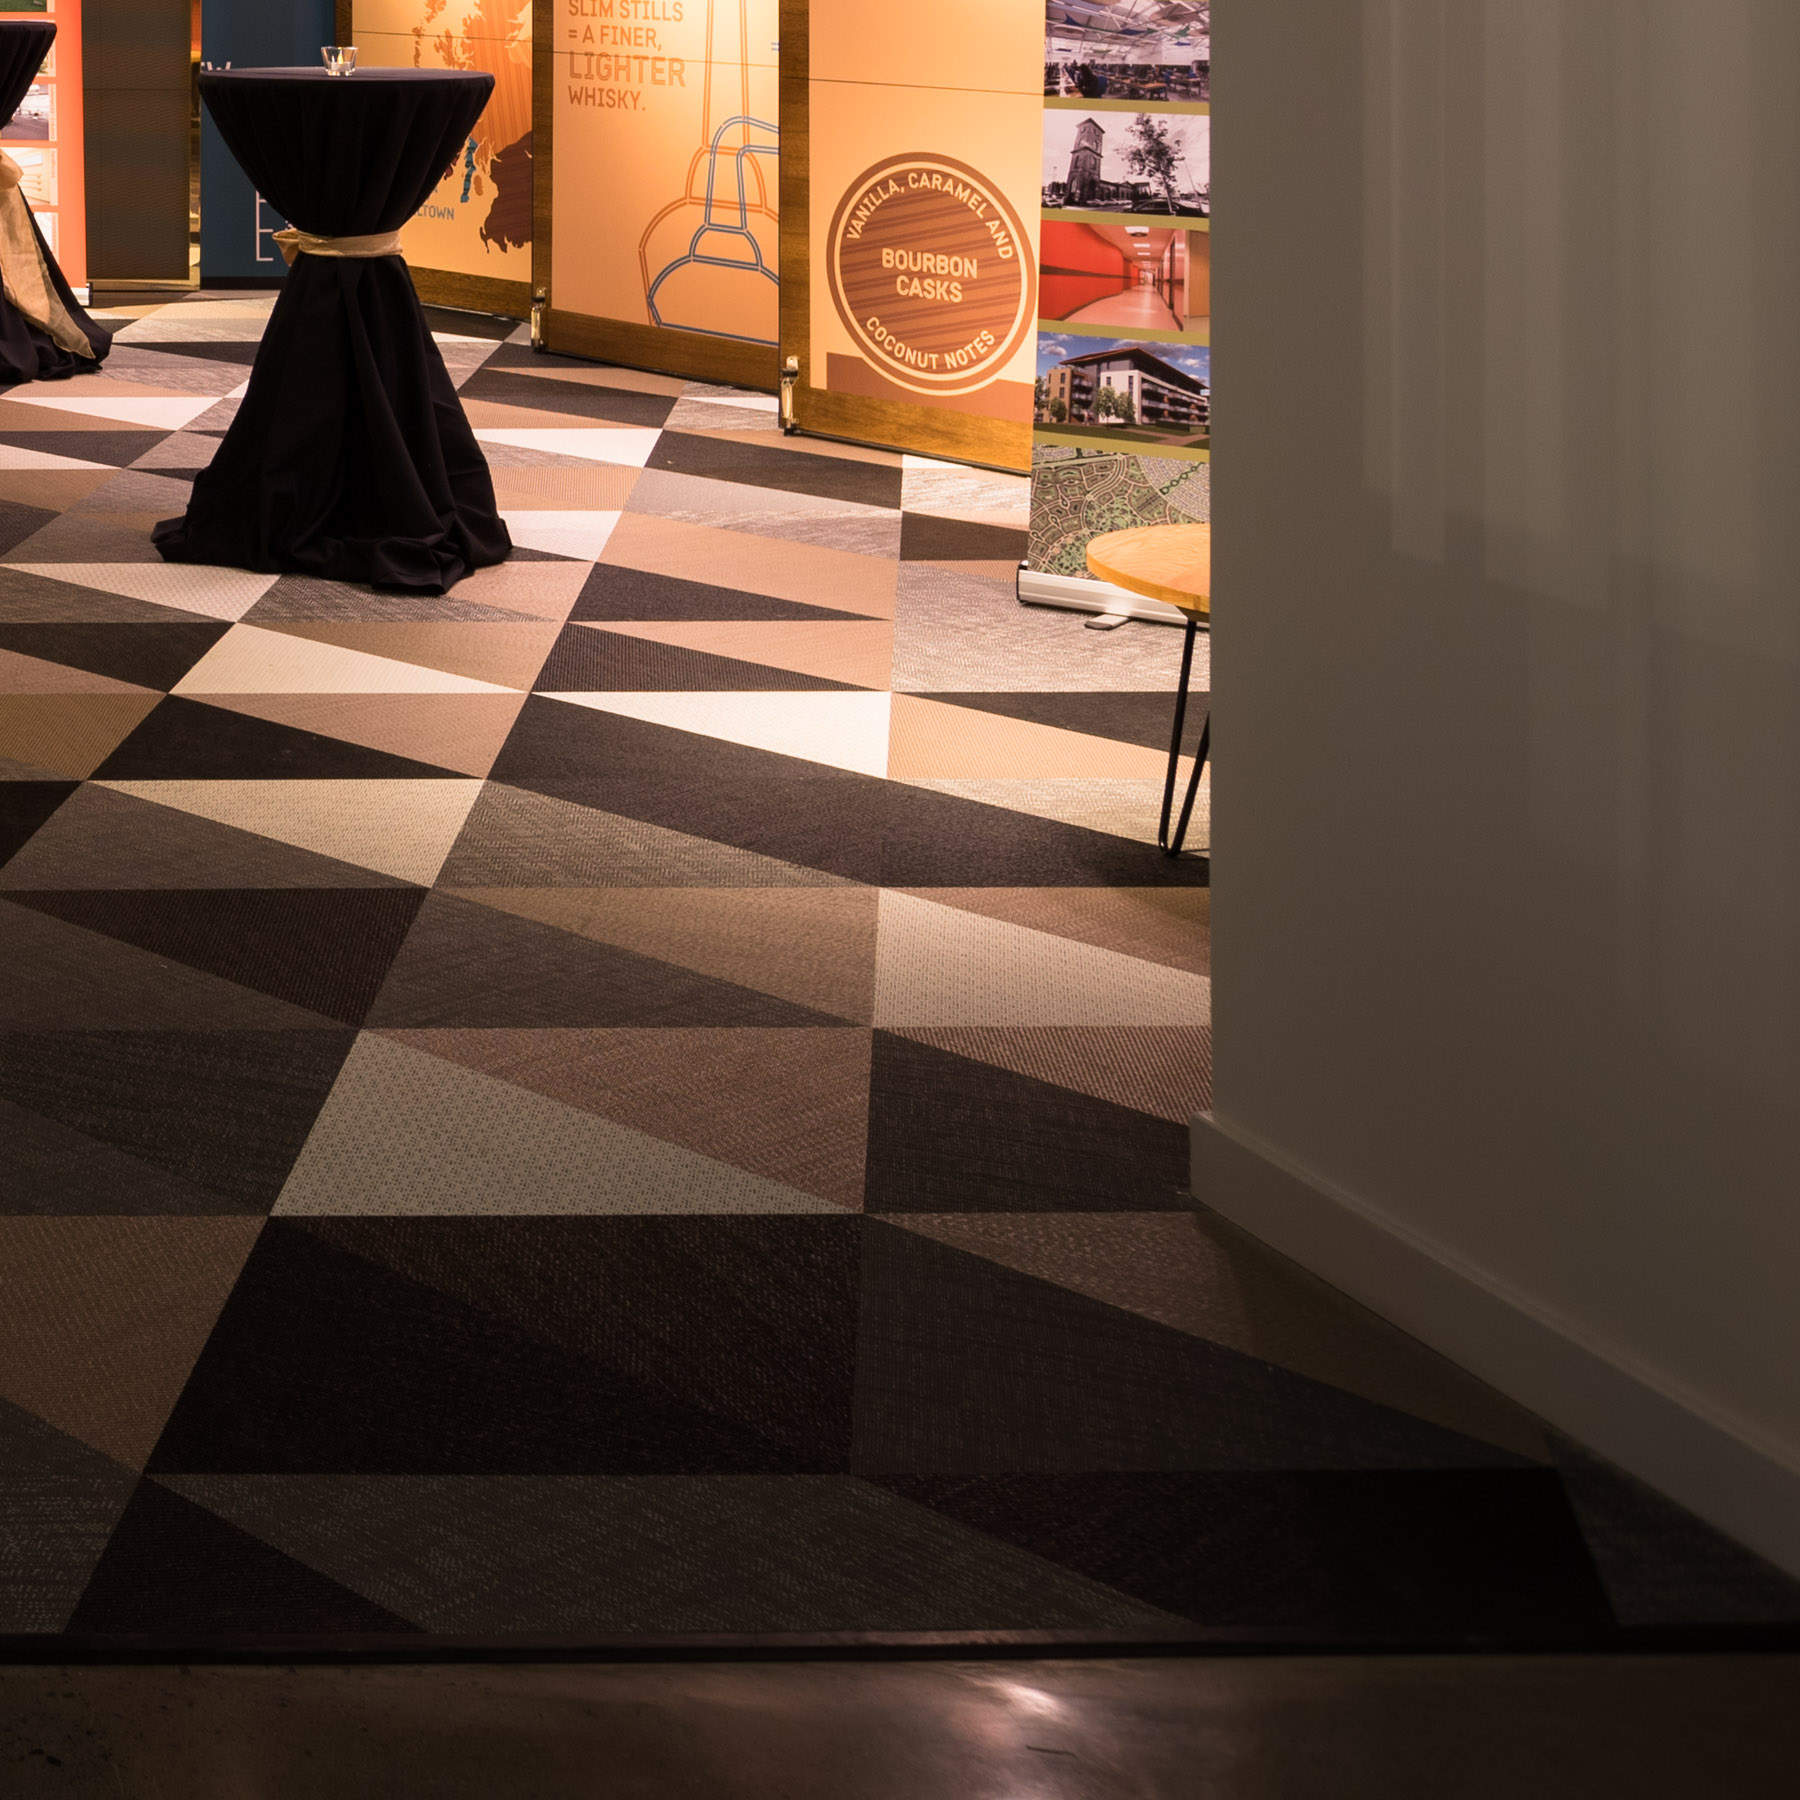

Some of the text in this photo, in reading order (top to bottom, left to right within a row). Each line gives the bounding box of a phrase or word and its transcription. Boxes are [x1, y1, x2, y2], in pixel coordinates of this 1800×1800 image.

[620, 0, 684, 22] STILLS
[582, 24, 594, 43] A
[600, 25, 662, 51] FINER,
[569, 51, 686, 87] LIGHTER
[568, 85, 645, 111] WHISKY.
[847, 173, 1013, 259] VANILLA, CARAMEL AND
[882, 248, 977, 278] BOURBON
[896, 275, 962, 303] CASKS
[867, 317, 995, 369] COCONUT NOTES
